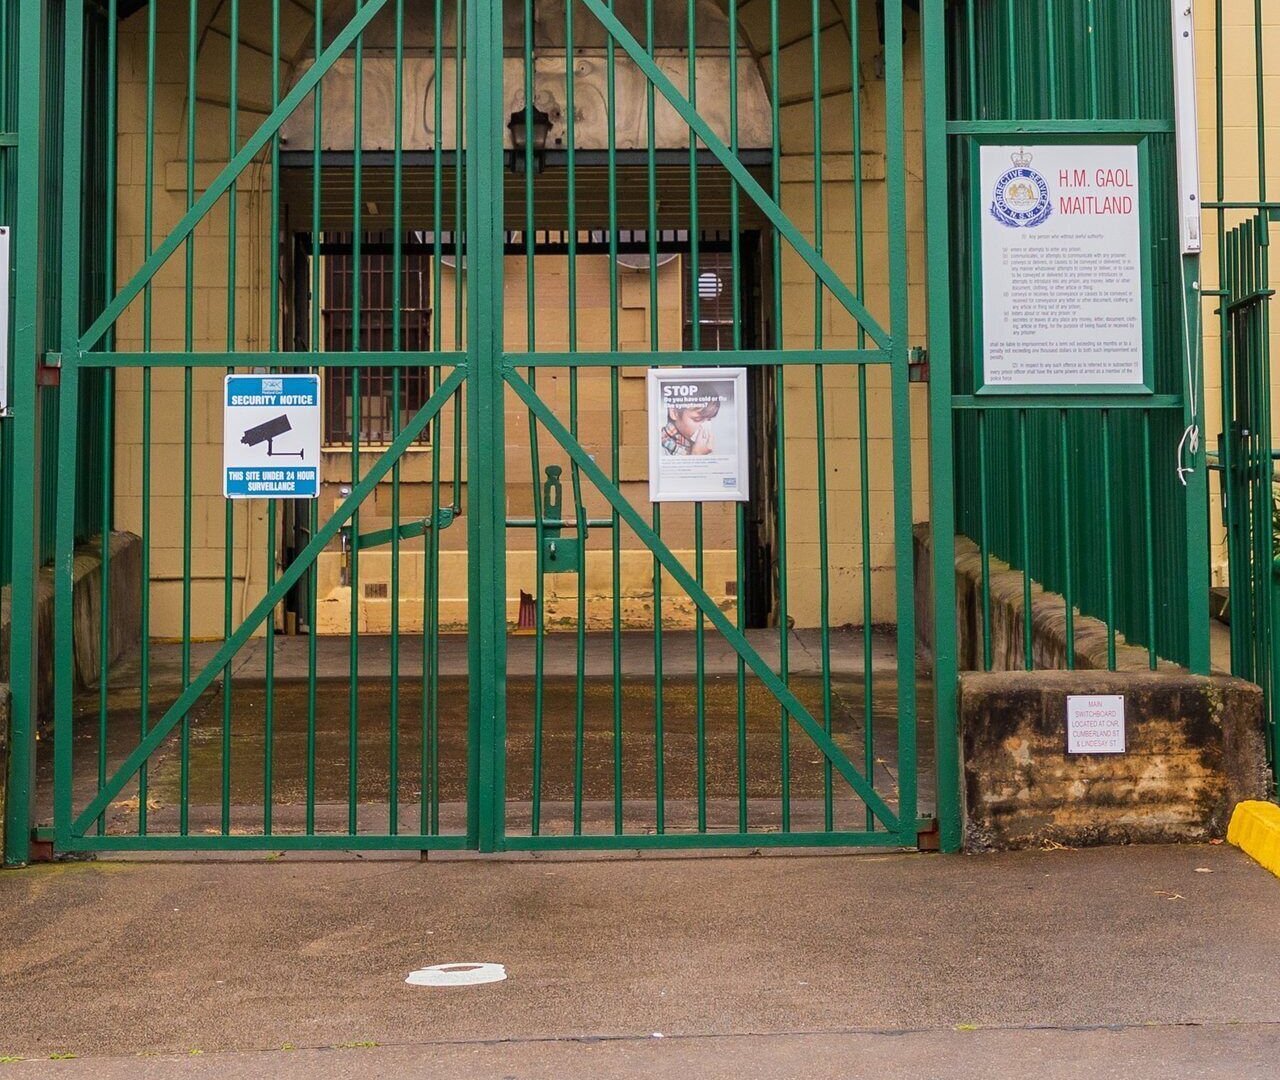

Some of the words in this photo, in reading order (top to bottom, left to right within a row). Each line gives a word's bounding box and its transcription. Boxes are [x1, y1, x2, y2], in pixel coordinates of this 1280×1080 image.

[1059, 169, 1090, 187] H.M.
[1095, 168, 1133, 187] GAOL
[996, 170, 1023, 211] CORRECTIVE
[1029, 171, 1048, 210] SERVICES
[1060, 196, 1133, 214] MAITLAND
[663, 385, 698, 396] STOP
[231, 395, 276, 405] SECURITY
[280, 395, 313, 405] NOTICE
[229, 471, 243, 480] THIS
[245, 471, 260, 480] SITE
[262, 471, 284, 480] UNDER
[286, 471, 295, 480] 24
[297, 471, 315, 480] HOUR
[247, 481, 295, 491] SURVEILLANCE
